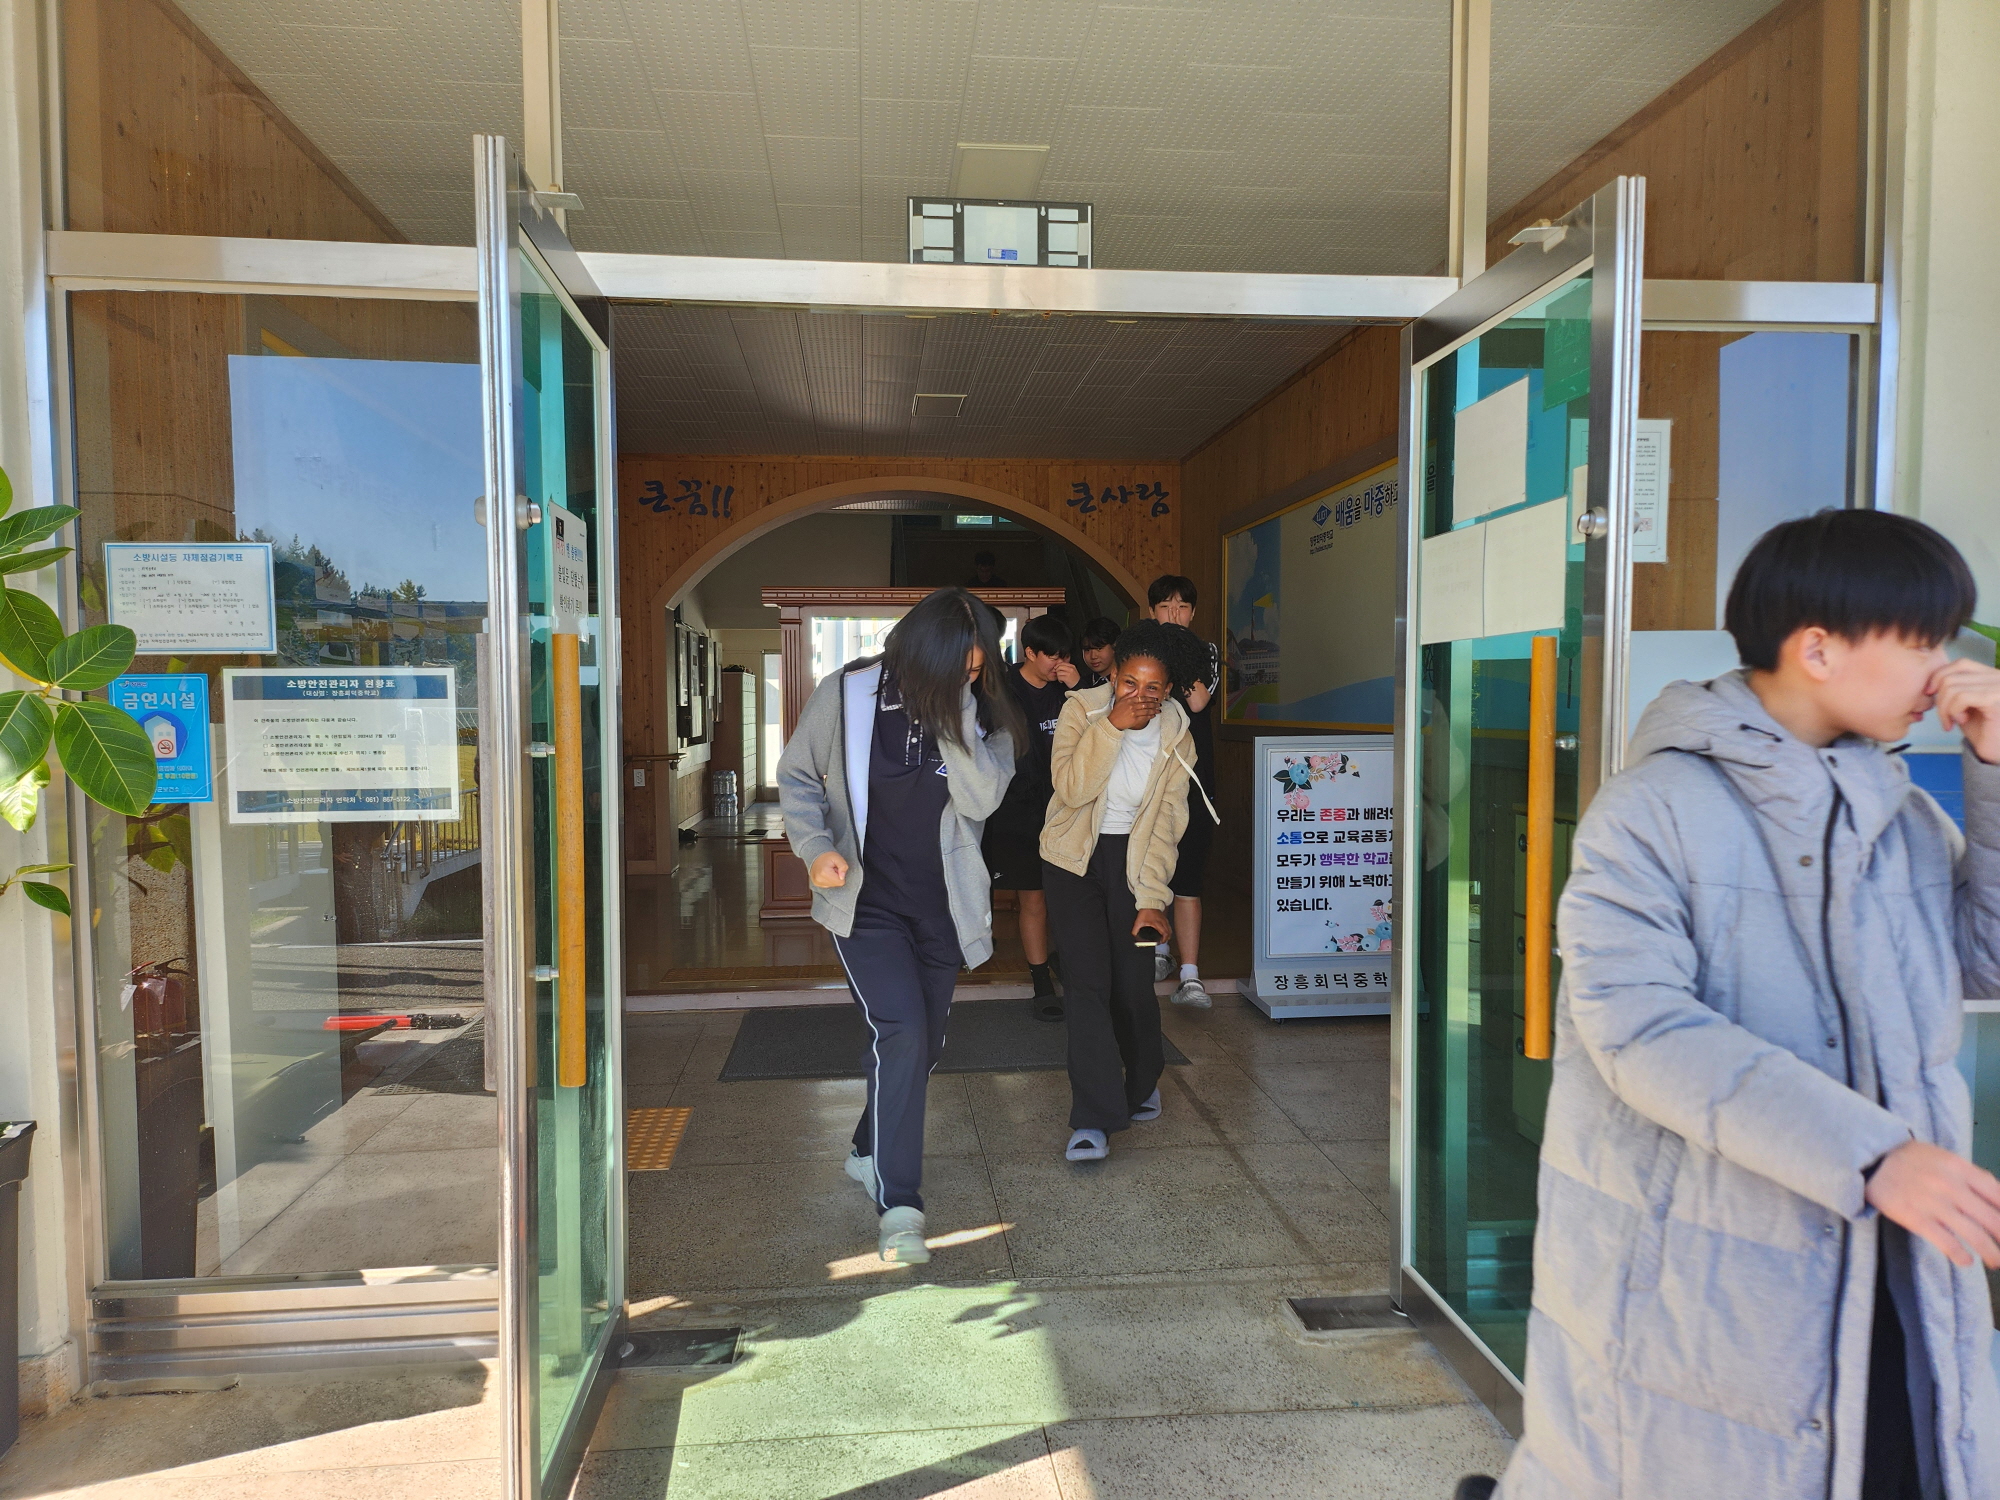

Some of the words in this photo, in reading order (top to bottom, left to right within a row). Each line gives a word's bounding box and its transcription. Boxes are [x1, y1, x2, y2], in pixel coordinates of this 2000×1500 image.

[1335, 495, 1362, 528] 배움을
[133, 553, 177, 562] 소방시설등
[183, 553, 244, 562] 자체점검기록표
[286, 679, 359, 689] 소방안전관리자
[364, 679, 396, 689] 현황표
[122, 692, 196, 710] 금연시설
[1277, 808, 1316, 822] 우리는
[1319, 808, 1360, 822] 존중과
[1276, 831, 1329, 845] 소통으로
[1276, 853, 1316, 867] 모두가
[1319, 852, 1360, 867] 행복한
[1362, 851, 1392, 865] 학교
[1276, 875, 1315, 890] 만들기
[1319, 875, 1345, 888] 위해
[1276, 897, 1333, 912] 있습니다.
